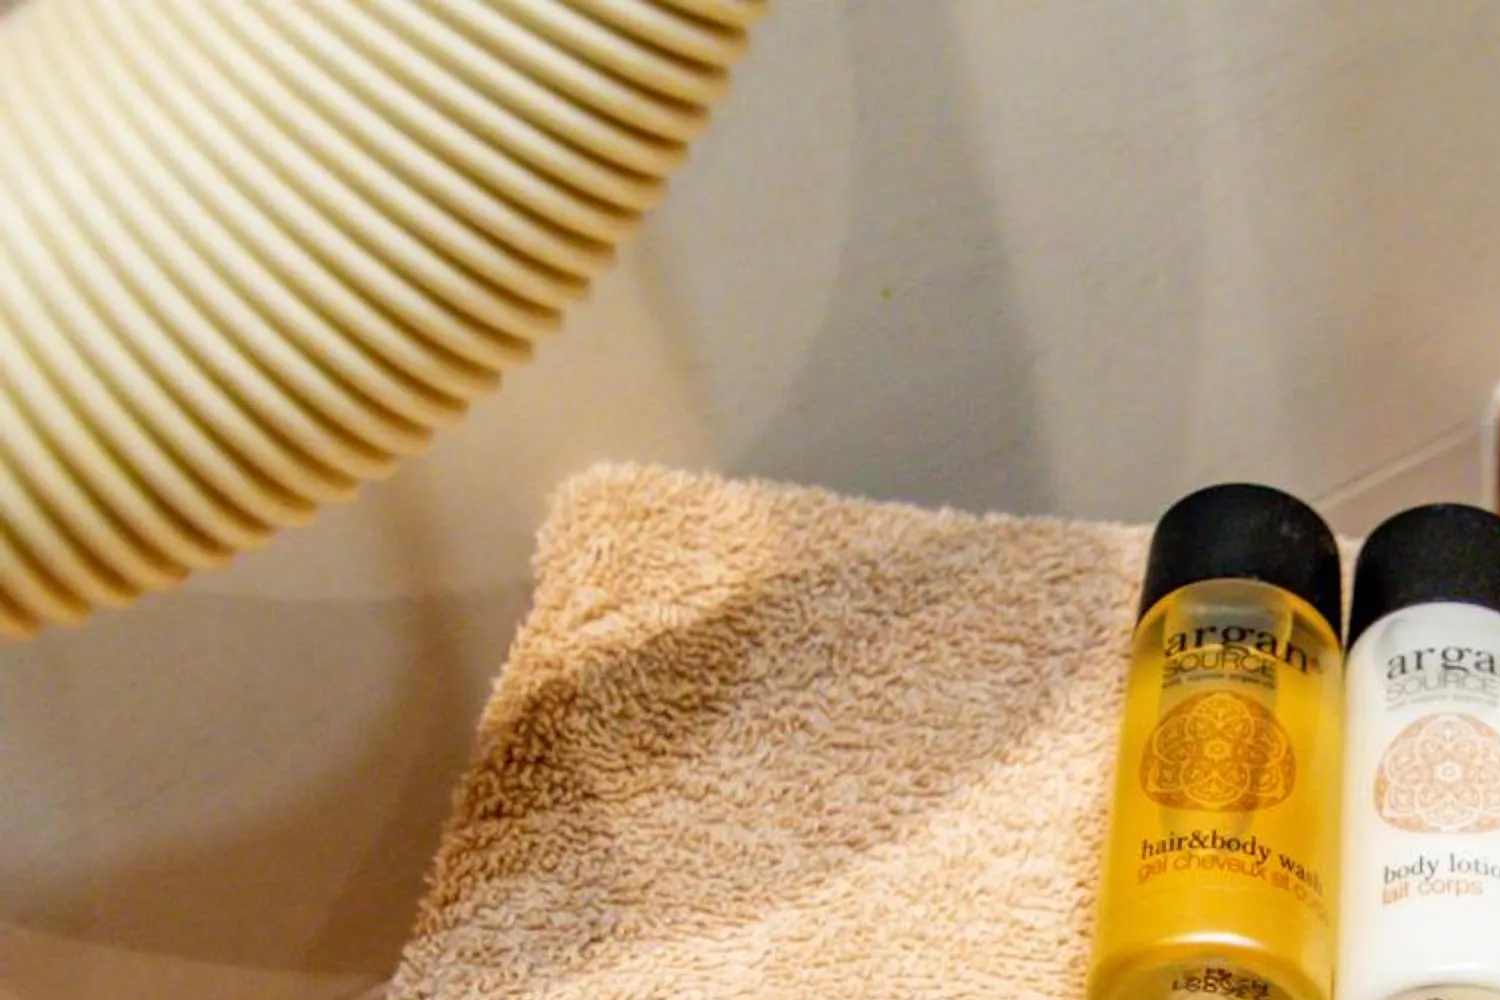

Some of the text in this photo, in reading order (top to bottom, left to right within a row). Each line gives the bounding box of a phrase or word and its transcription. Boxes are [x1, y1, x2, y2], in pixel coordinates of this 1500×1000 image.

[1165, 625, 1310, 676] argan
[1162, 651, 1278, 682] SOURCE
[1385, 672, 1500, 702] SOURCE
[1141, 829, 1271, 866] hair&body
[1383, 855, 1440, 885] body
[1417, 876, 1485, 897] corps
